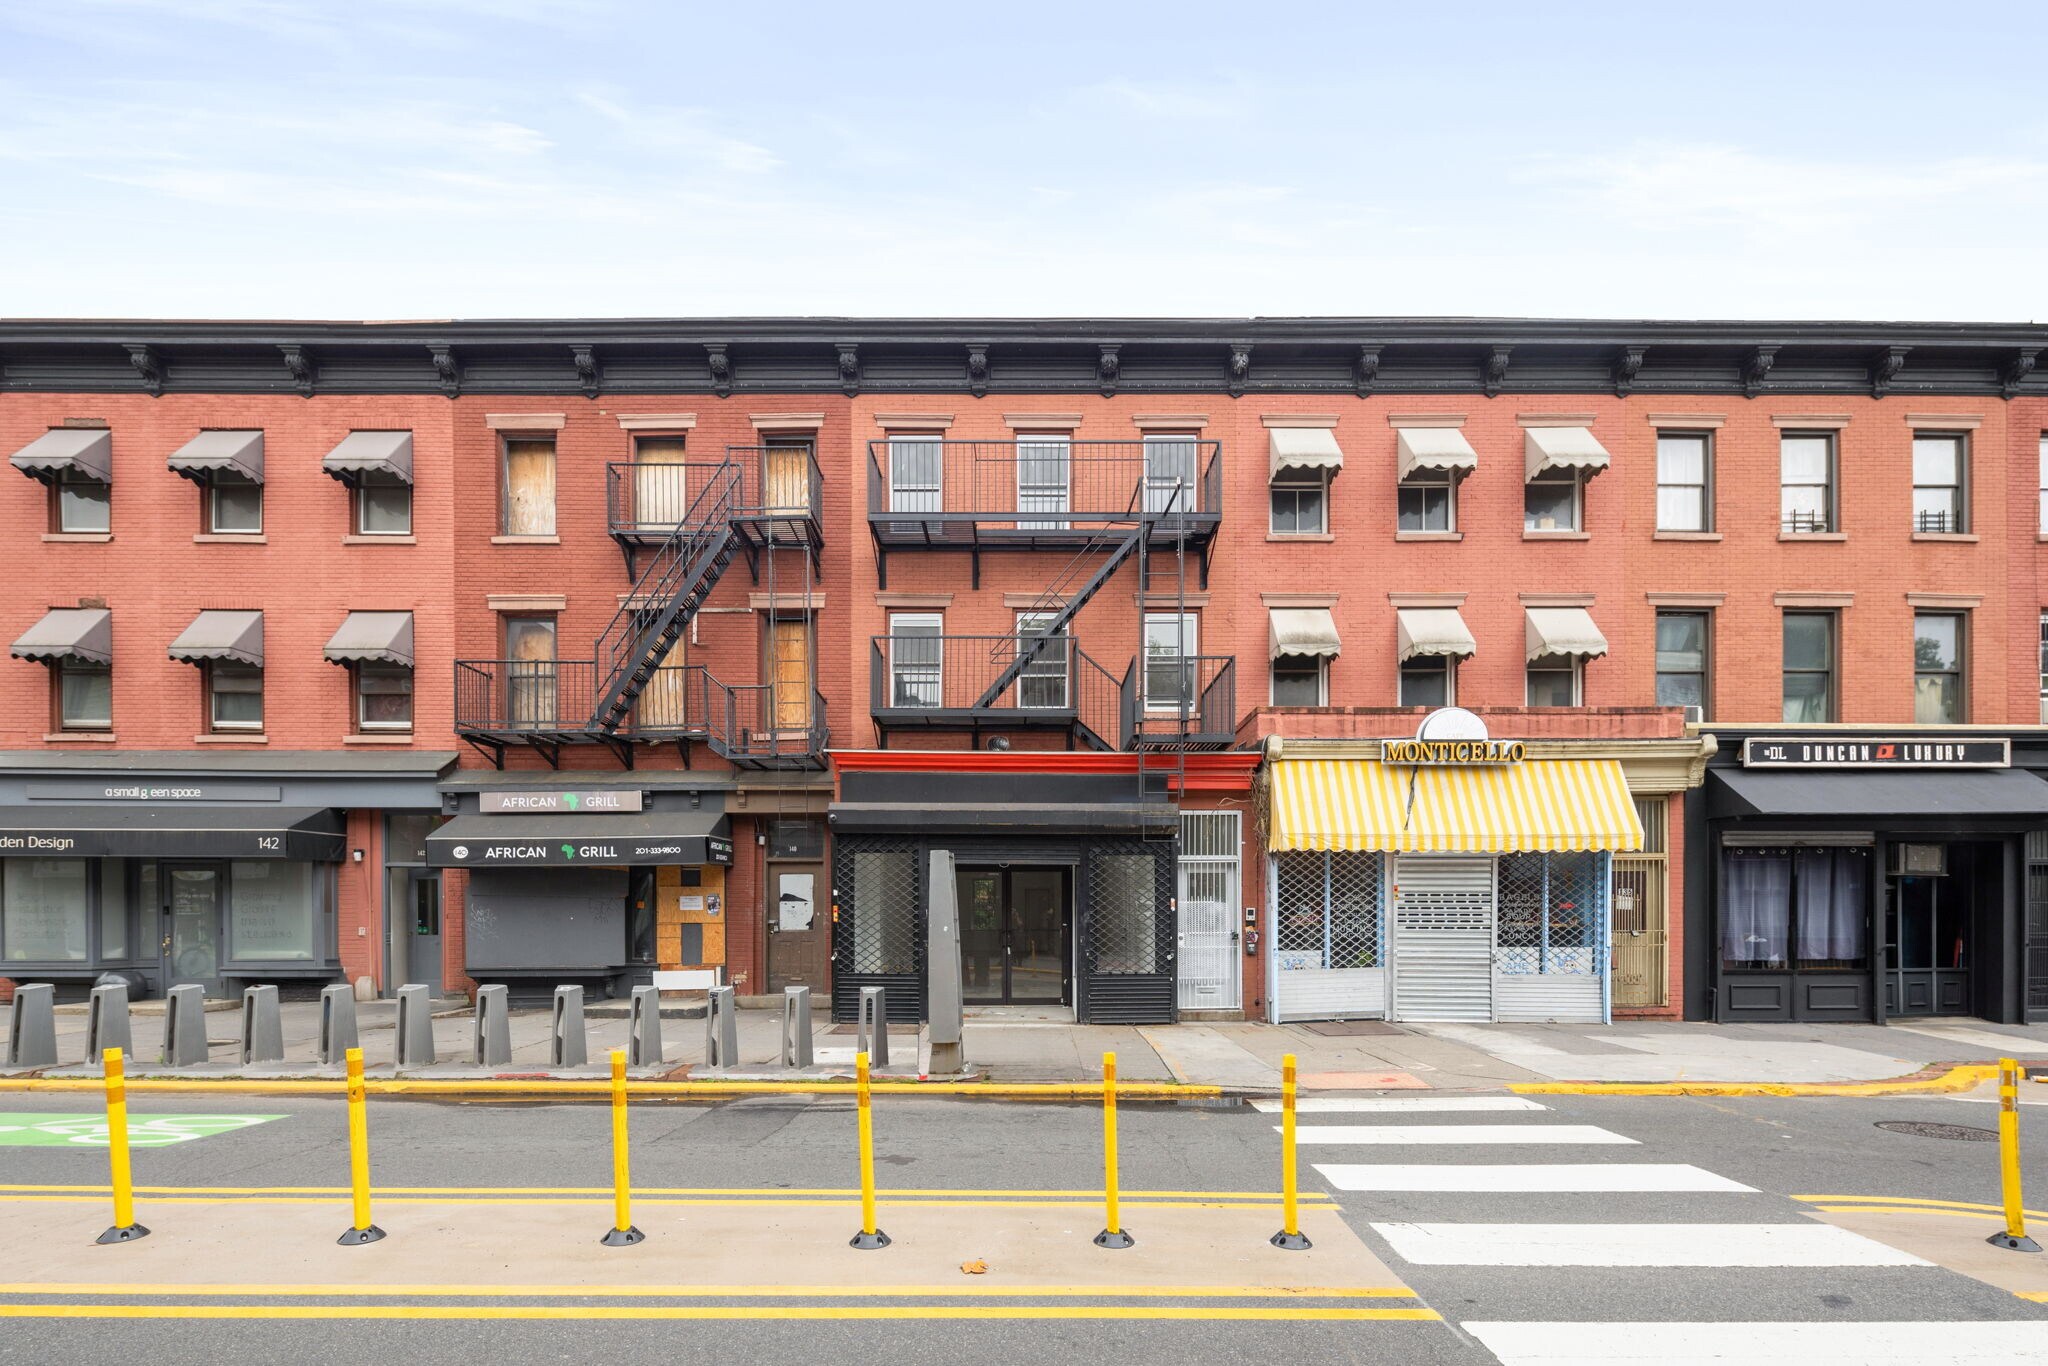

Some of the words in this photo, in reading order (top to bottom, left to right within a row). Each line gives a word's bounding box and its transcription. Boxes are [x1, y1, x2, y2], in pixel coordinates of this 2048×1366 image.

[1385, 741, 1526, 762] MONTICELLO
[1803, 745, 1869, 761] DUNCAN
[1904, 745, 1965, 761] LUXURY
[105, 788, 112, 797] a
[113, 787, 139, 797] small
[171, 788, 201, 799] space
[502, 797, 557, 808] AFRICAN
[586, 796, 620, 807] GRILL
[0, 836, 24, 848] den
[28, 836, 74, 851] Design
[257, 837, 280, 849] 142
[485, 847, 546, 858] AFRICAN
[579, 846, 617, 858] GRILL
